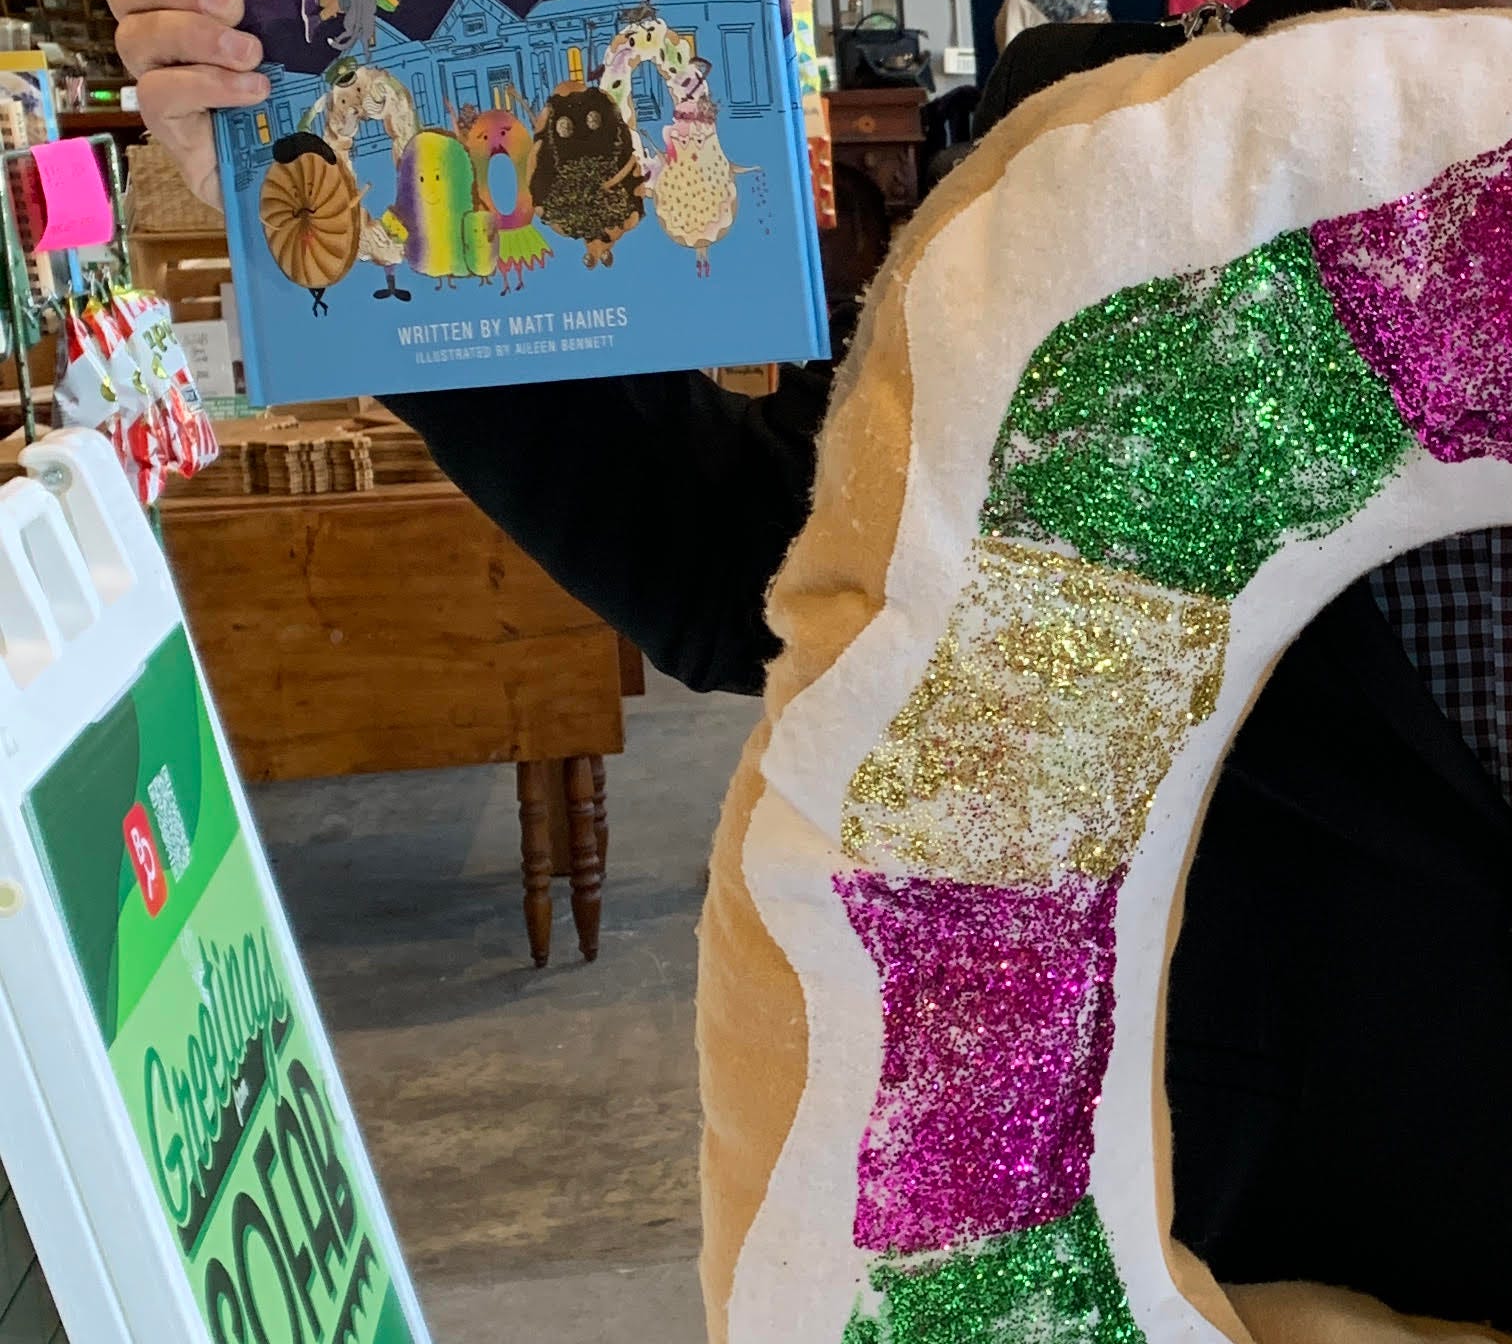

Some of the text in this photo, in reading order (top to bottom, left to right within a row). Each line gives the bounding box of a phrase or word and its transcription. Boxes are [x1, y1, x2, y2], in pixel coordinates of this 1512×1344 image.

[398, 307, 628, 346] WRITTEN BY MATT HAINES
[415, 346, 491, 364] ILLUSTRATED
[144, 927, 287, 1225] Greetings
